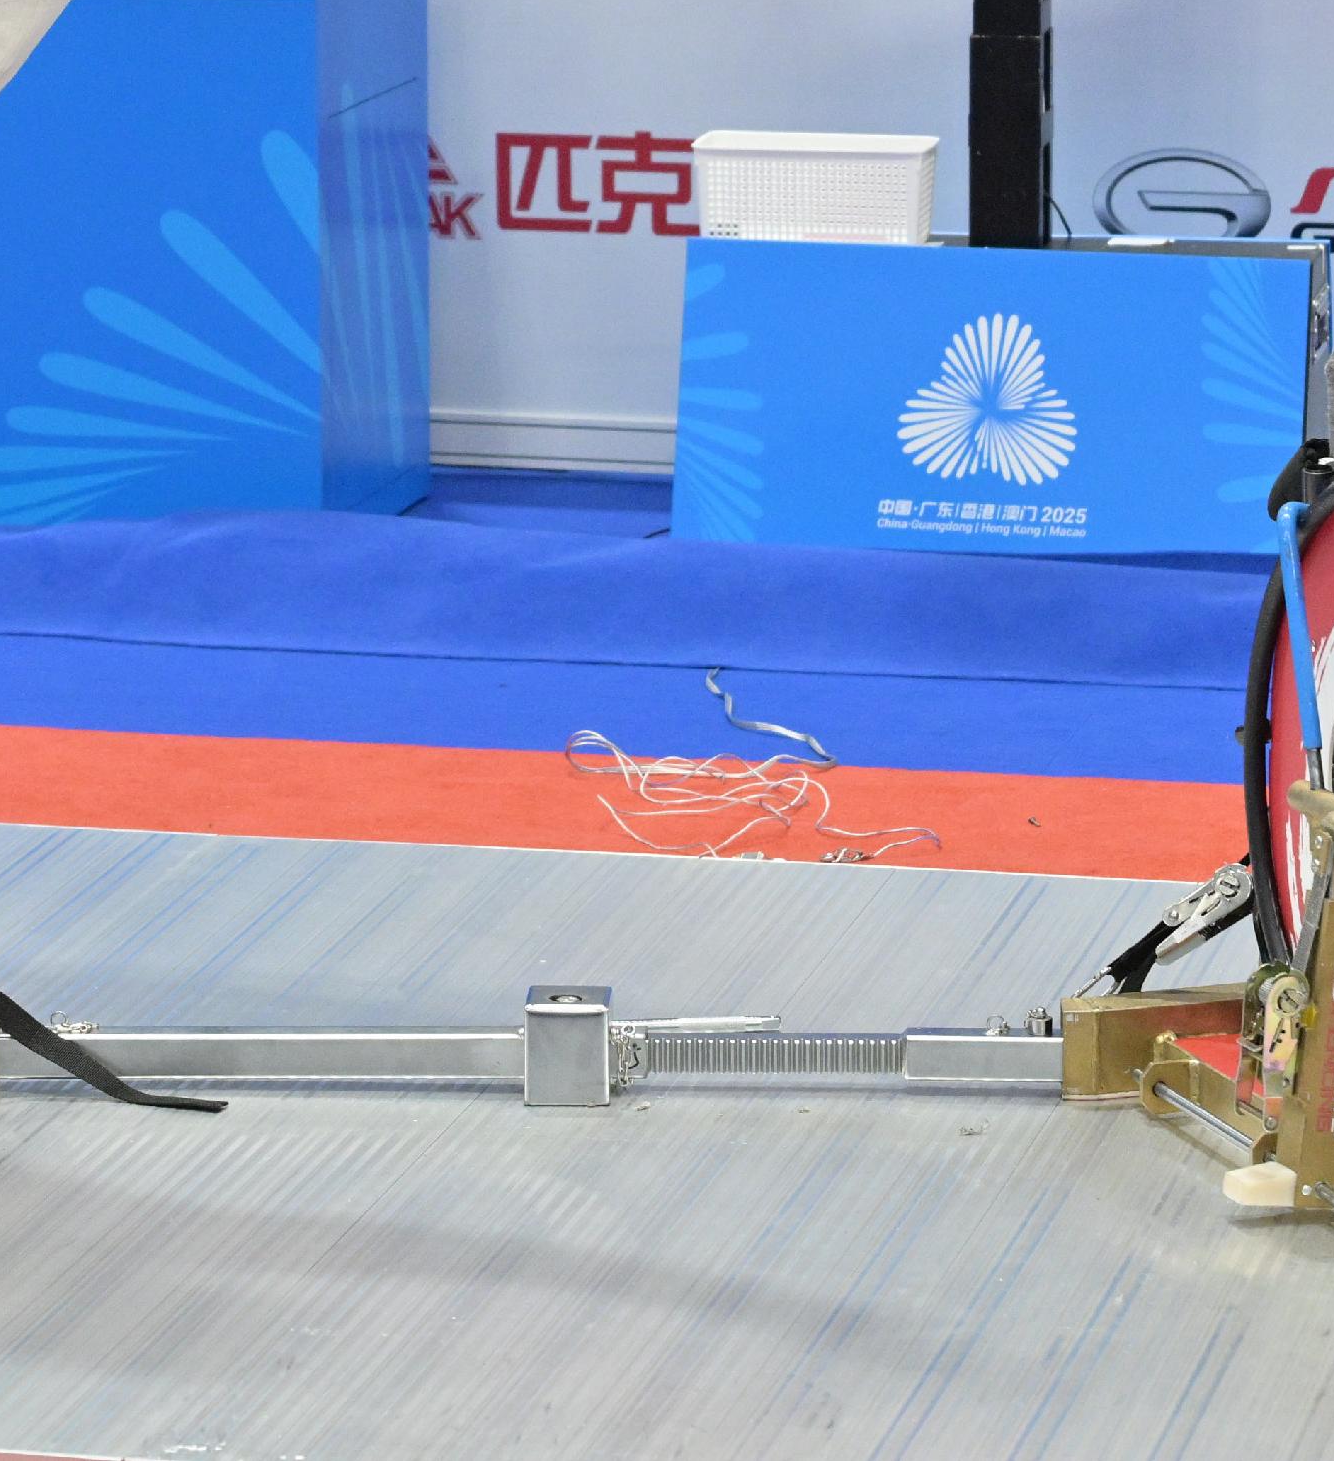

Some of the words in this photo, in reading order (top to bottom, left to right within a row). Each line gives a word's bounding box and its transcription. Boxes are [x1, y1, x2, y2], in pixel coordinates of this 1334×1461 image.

[496, 131, 701, 237] 匹克
[1040, 506, 1088, 524] 2025
[981, 522, 1010, 536] Hong
[1013, 524, 1041, 537] Kong
[1050, 525, 1087, 538] Macao
